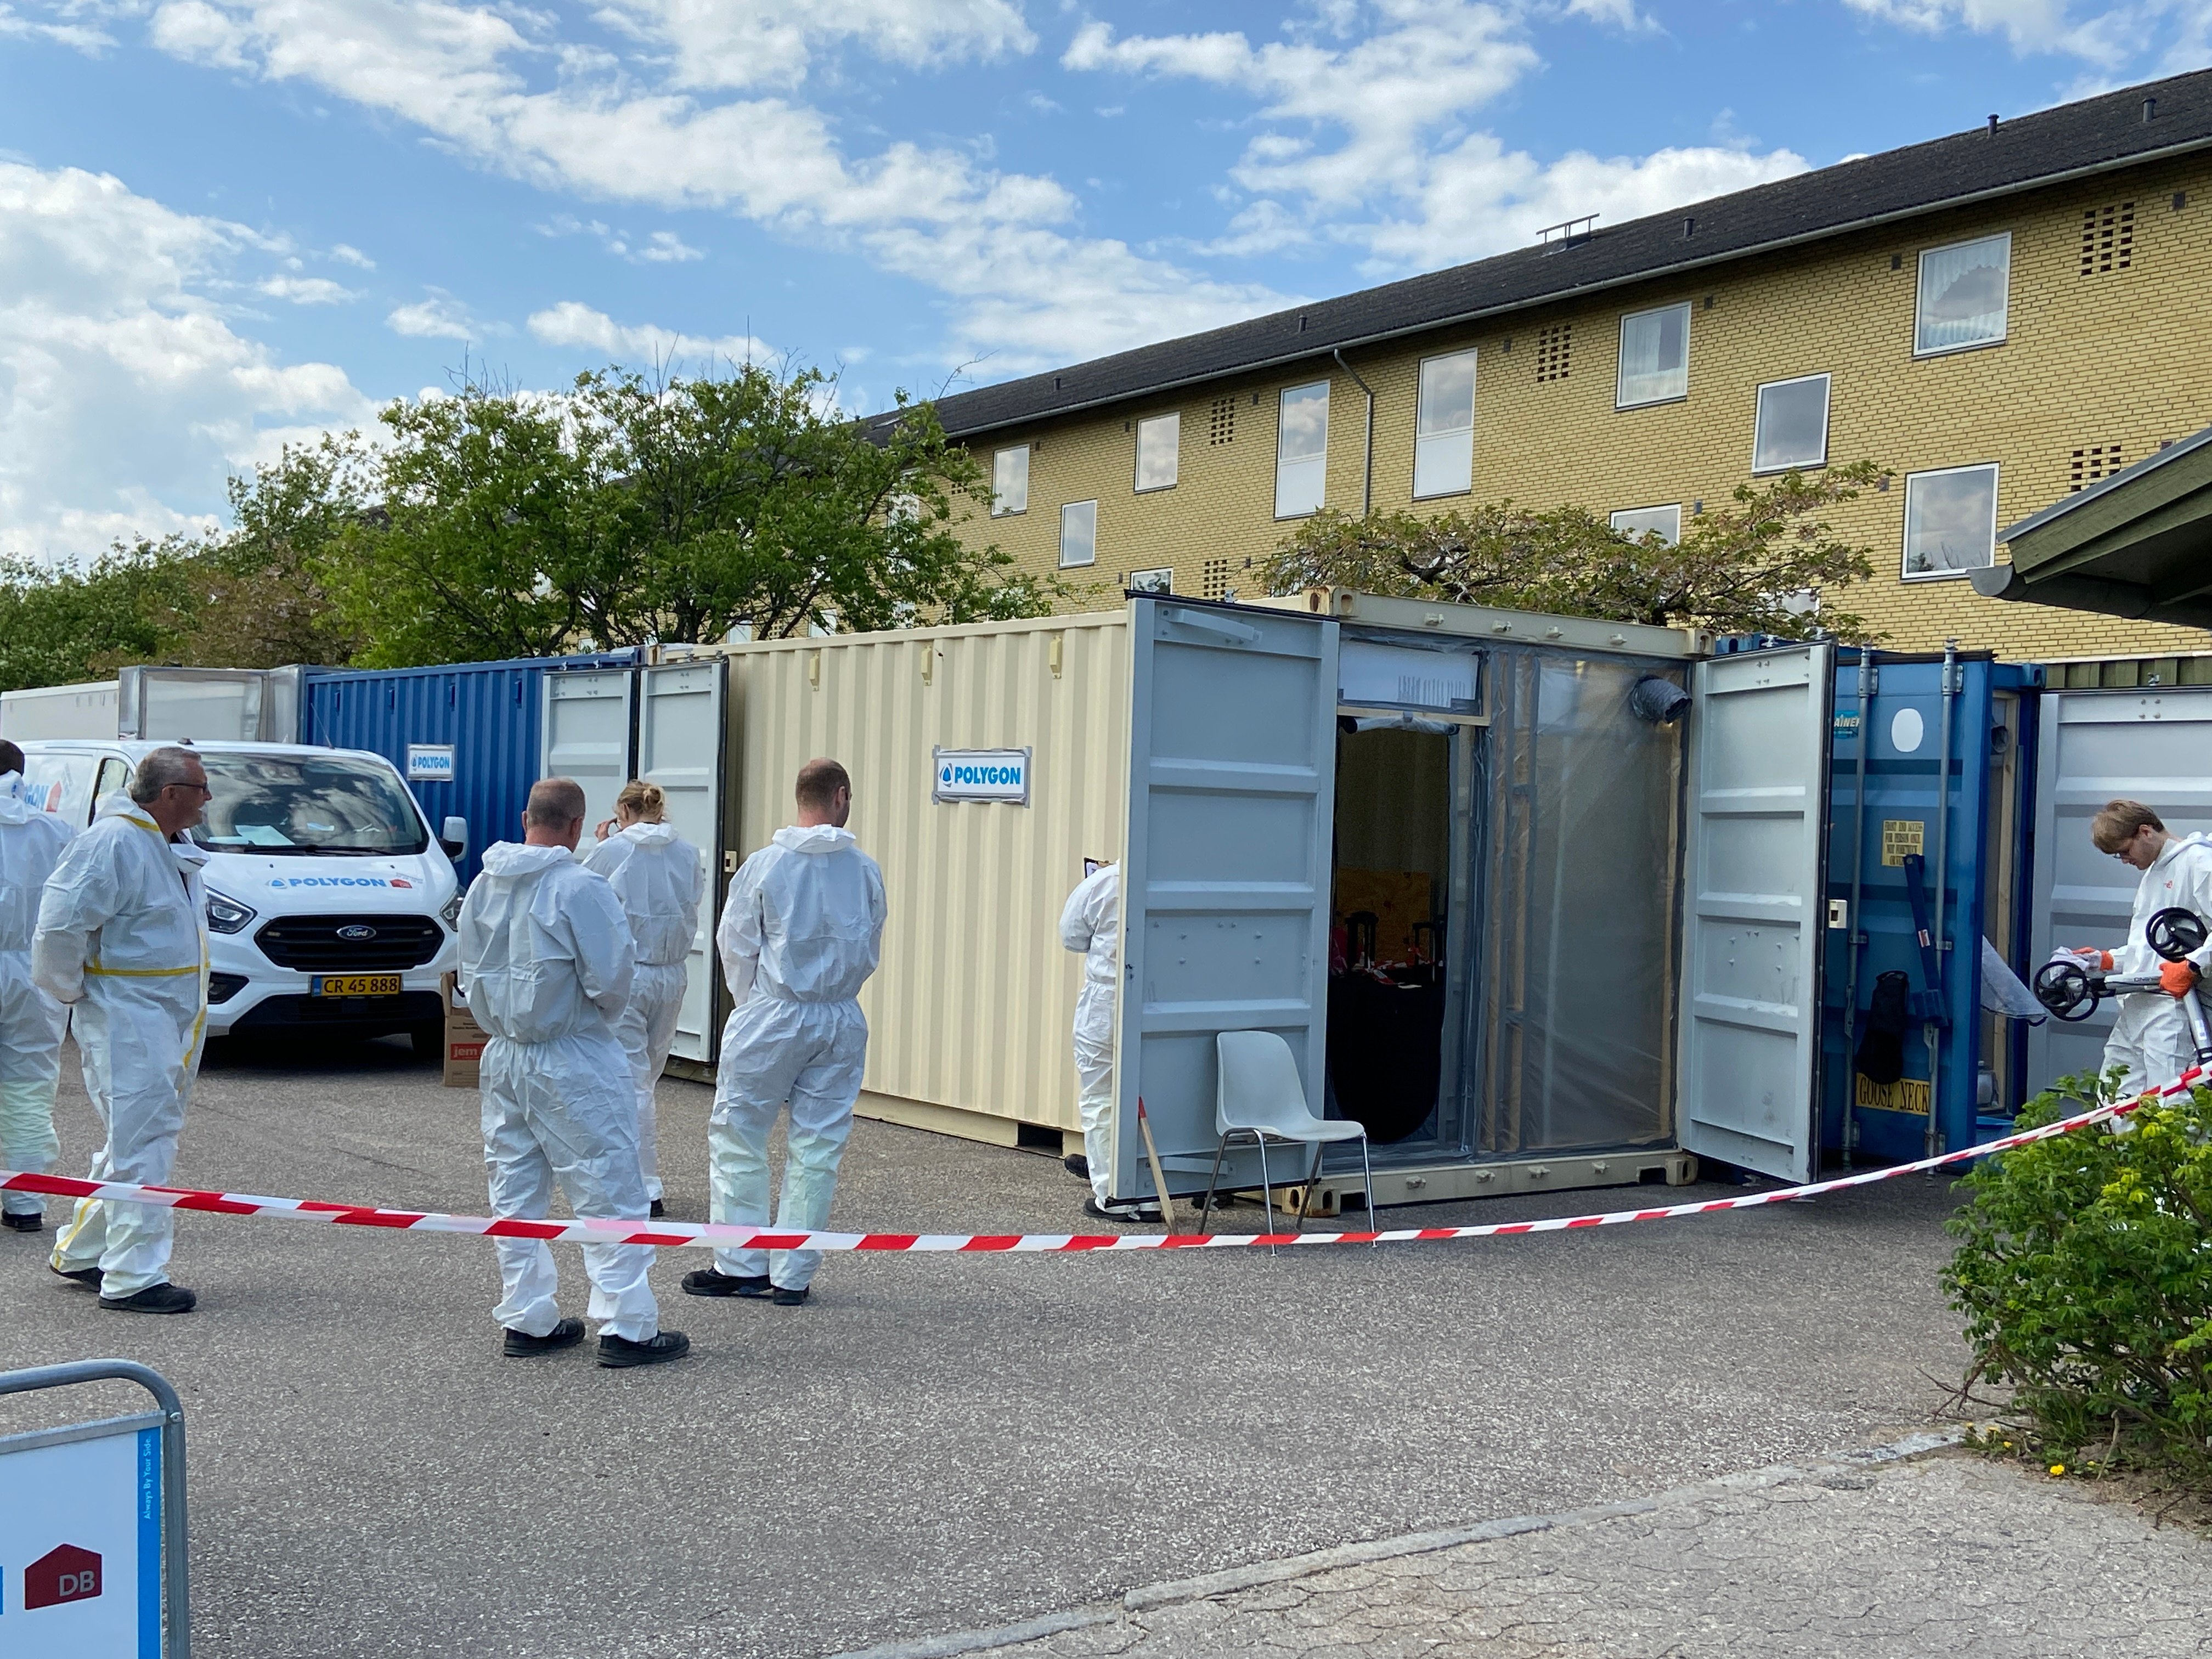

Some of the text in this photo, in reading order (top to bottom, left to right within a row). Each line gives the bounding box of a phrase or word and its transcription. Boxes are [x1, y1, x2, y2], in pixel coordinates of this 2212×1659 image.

[418, 757, 449, 768] POLYGON
[955, 766, 1020, 785] POLYGON
[288, 878, 387, 887] POLYGON
[346, 928, 368, 936] Ford
[324, 978, 397, 993] CR 45 888
[1860, 1076, 1929, 1113] GOOSE NECK
[143, 1479, 154, 1489] By
[143, 1491, 153, 1519] Always
[59, 1570, 95, 1597] DB
